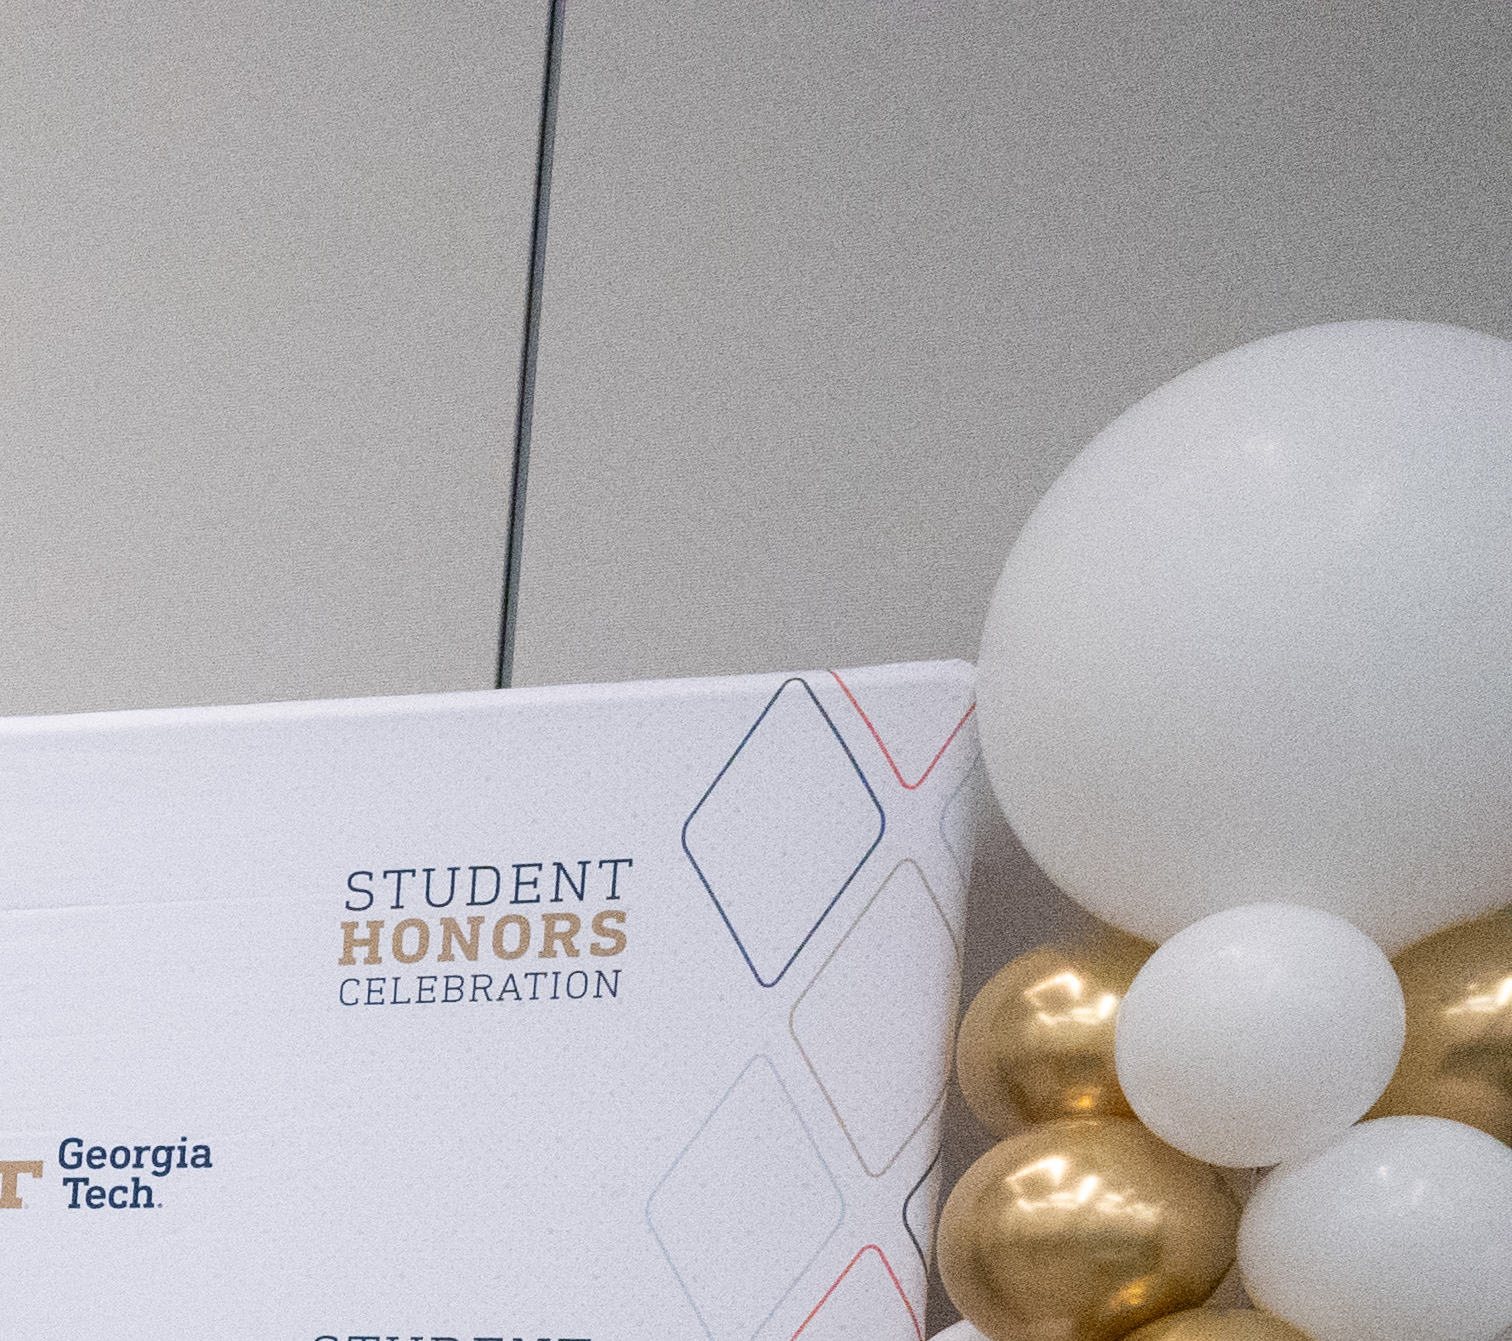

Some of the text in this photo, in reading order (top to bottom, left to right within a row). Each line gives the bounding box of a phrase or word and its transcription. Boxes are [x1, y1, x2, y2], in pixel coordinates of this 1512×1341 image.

[345, 858, 633, 911] STUDENT
[340, 911, 626, 965] HONORS
[340, 969, 621, 1006] CELEBRATION
[58, 1136, 213, 1178] Georgia
